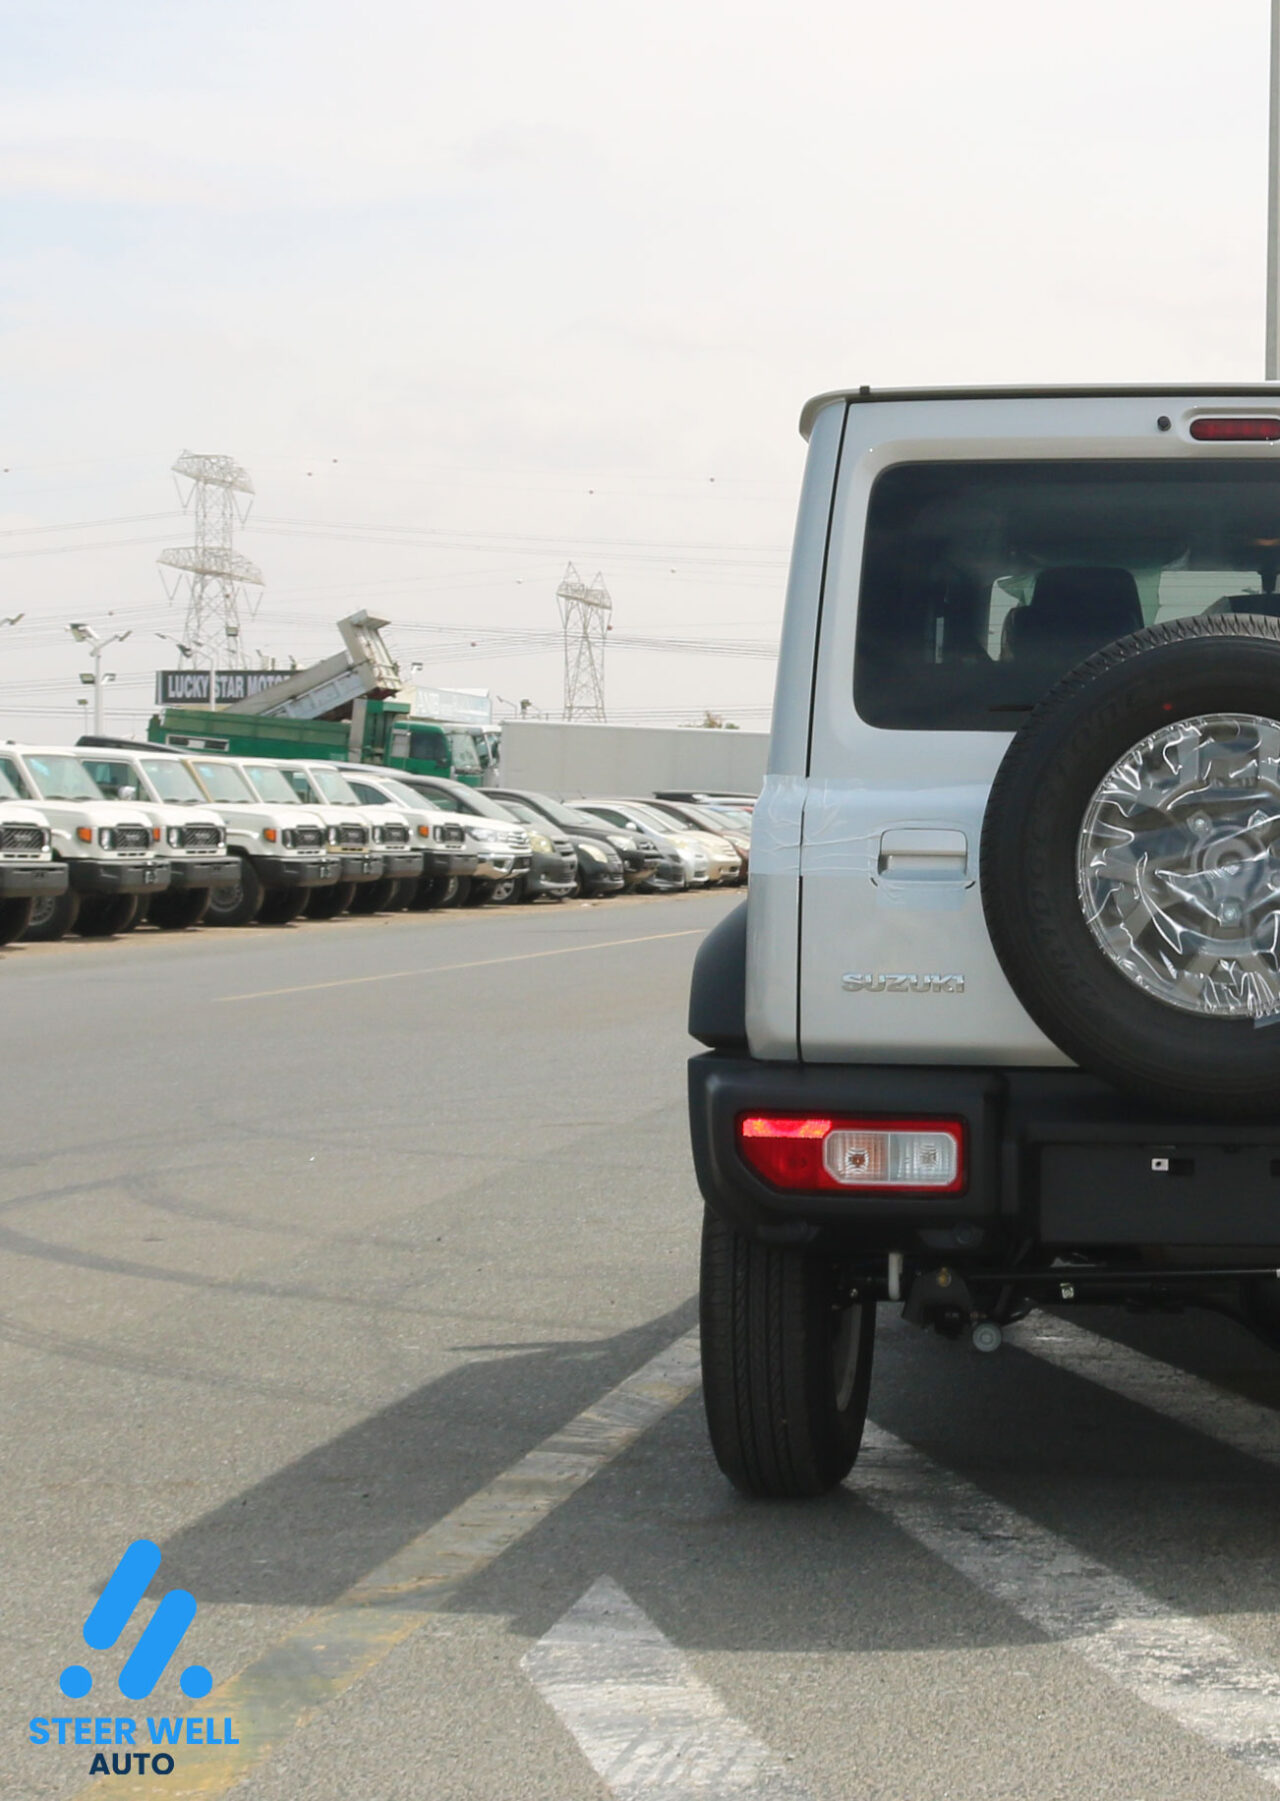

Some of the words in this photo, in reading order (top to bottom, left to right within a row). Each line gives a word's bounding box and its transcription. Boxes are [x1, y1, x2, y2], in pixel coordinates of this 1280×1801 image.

[168, 675, 209, 698] LUCKY
[214, 675, 244, 698] STAR
[247, 675, 291, 697] MOT
[842, 972, 965, 993] SUZUKI
